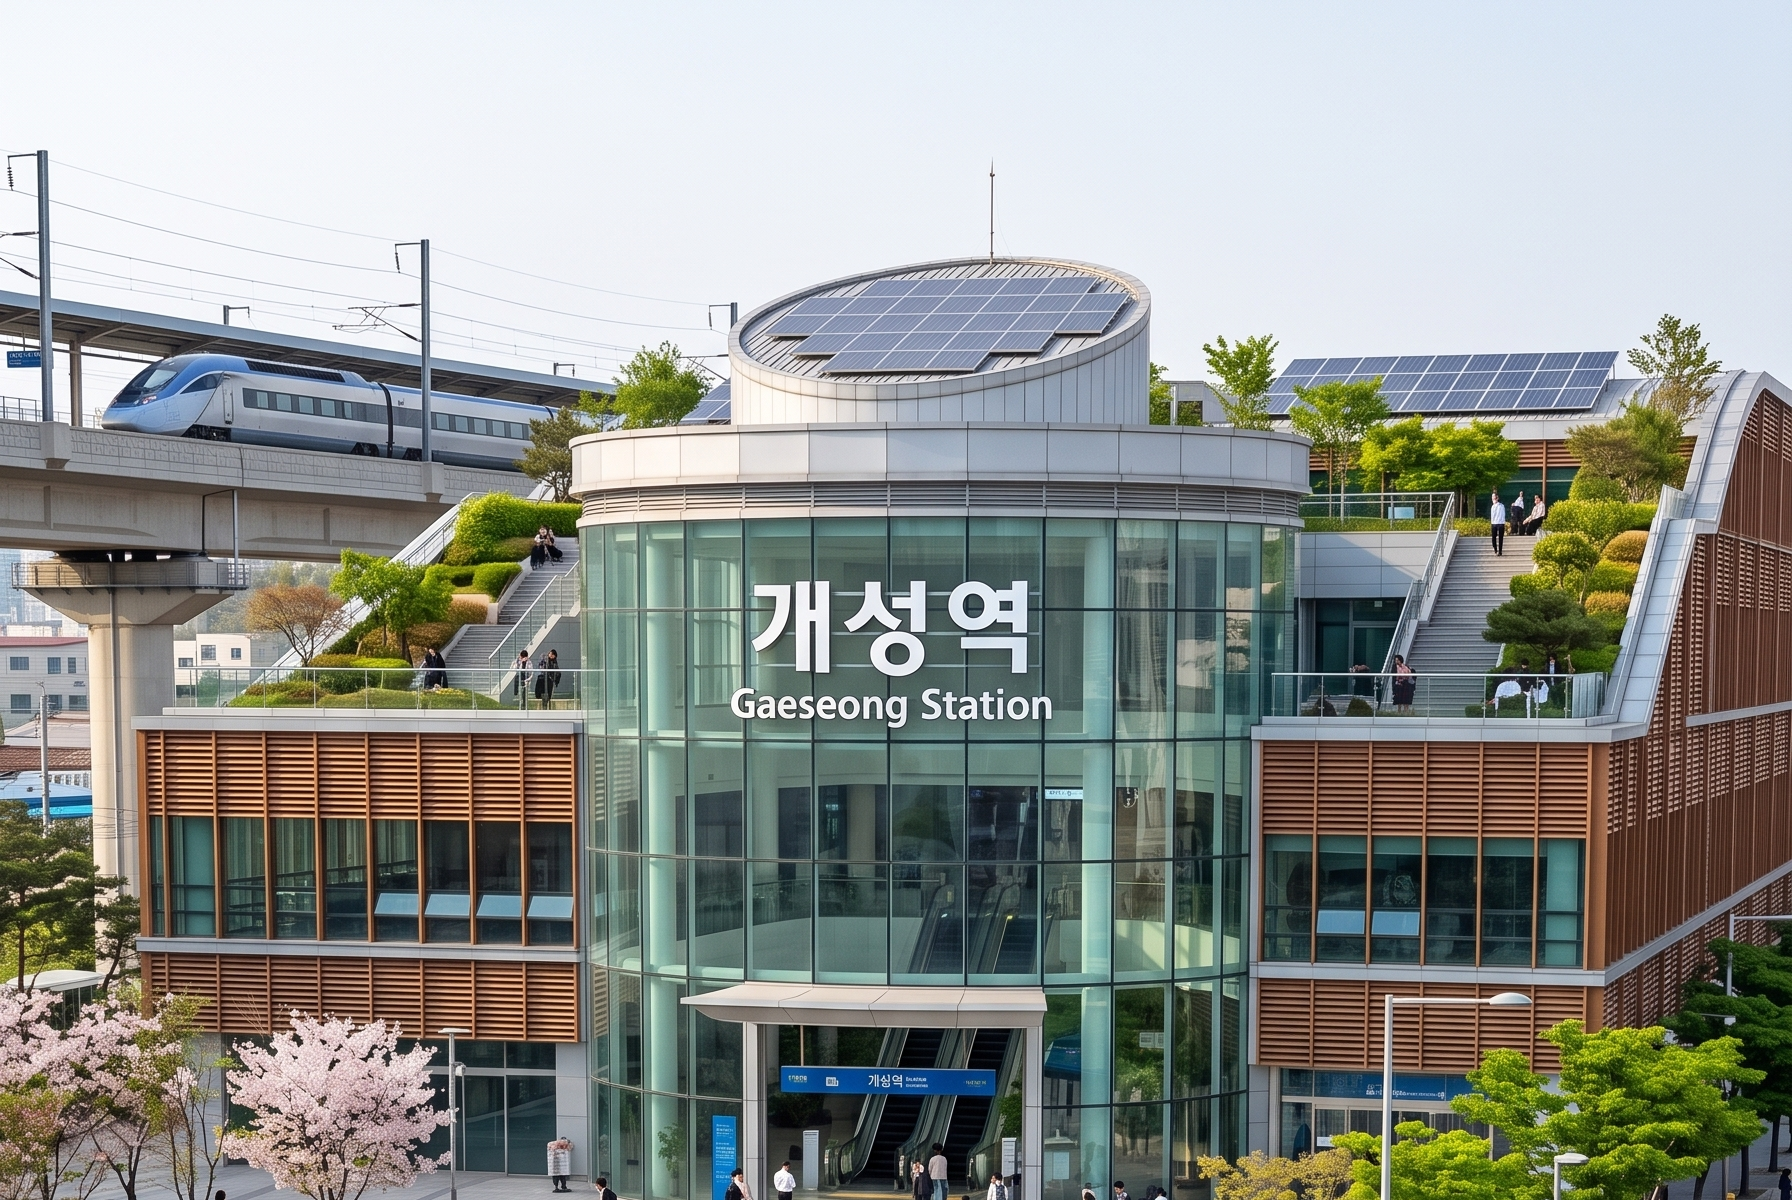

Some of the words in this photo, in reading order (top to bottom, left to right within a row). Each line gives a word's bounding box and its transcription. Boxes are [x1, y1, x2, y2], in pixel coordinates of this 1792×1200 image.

[751, 580, 1028, 677] 개성역
[730, 687, 908, 729] Gaeseong
[921, 688, 1053, 721] Station
